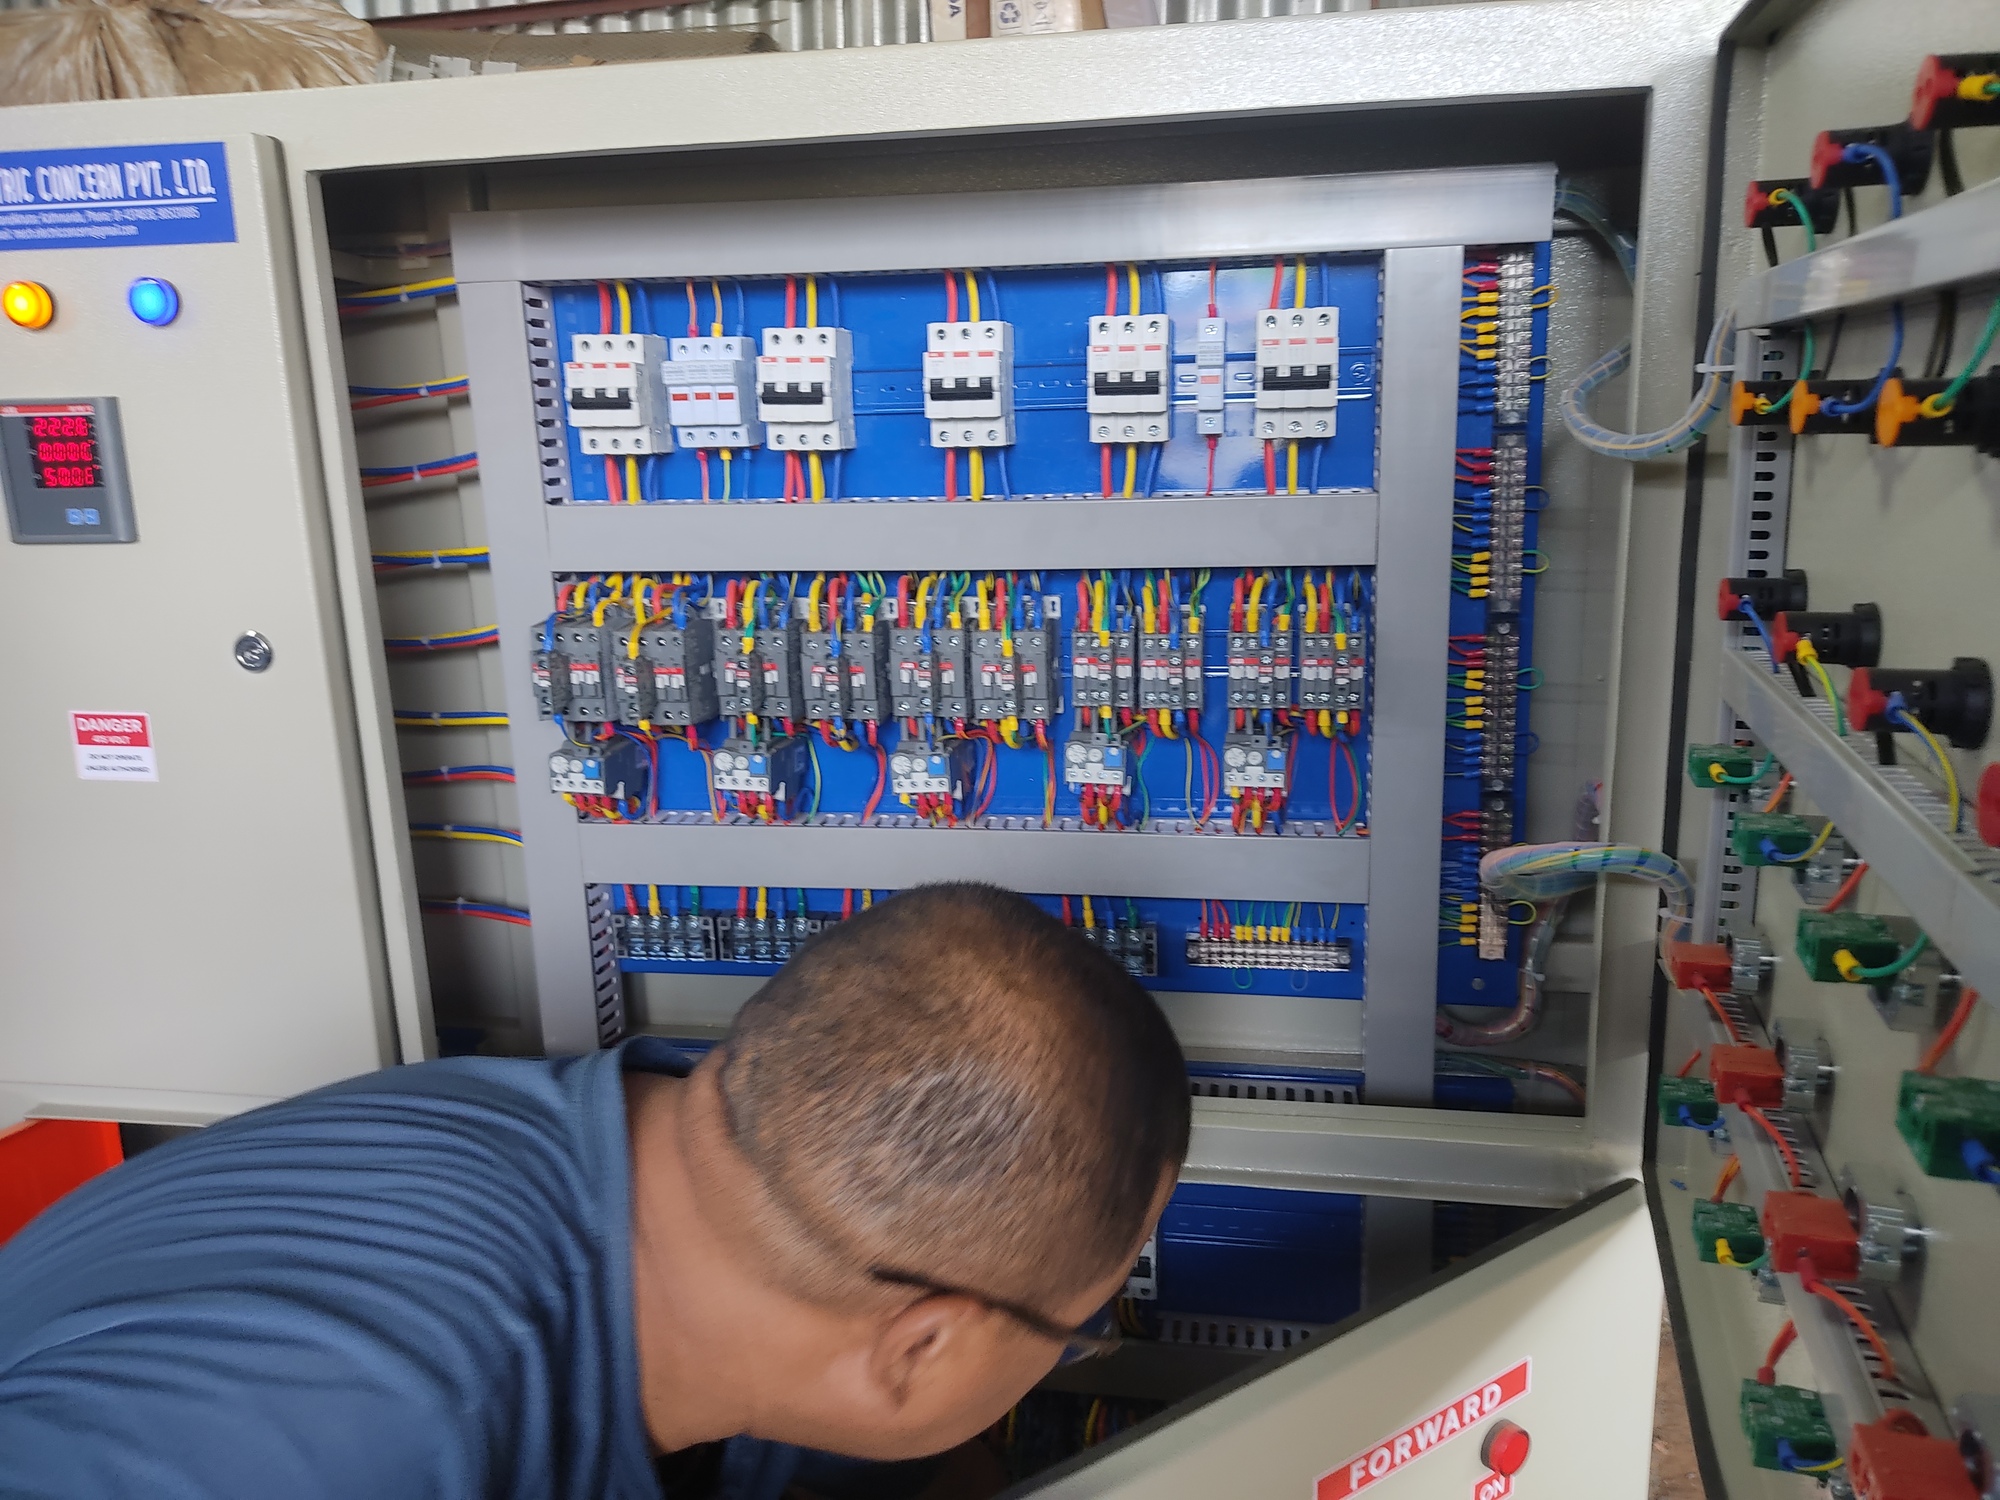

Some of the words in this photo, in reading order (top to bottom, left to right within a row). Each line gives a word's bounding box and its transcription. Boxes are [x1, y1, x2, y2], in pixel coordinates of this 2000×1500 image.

[35, 163, 125, 202] CONCERN
[124, 160, 172, 198] PVT.
[76, 717, 143, 733] DANGER
[1349, 1382, 1502, 1491] FORWARD
[1479, 1474, 1505, 1500] ON
